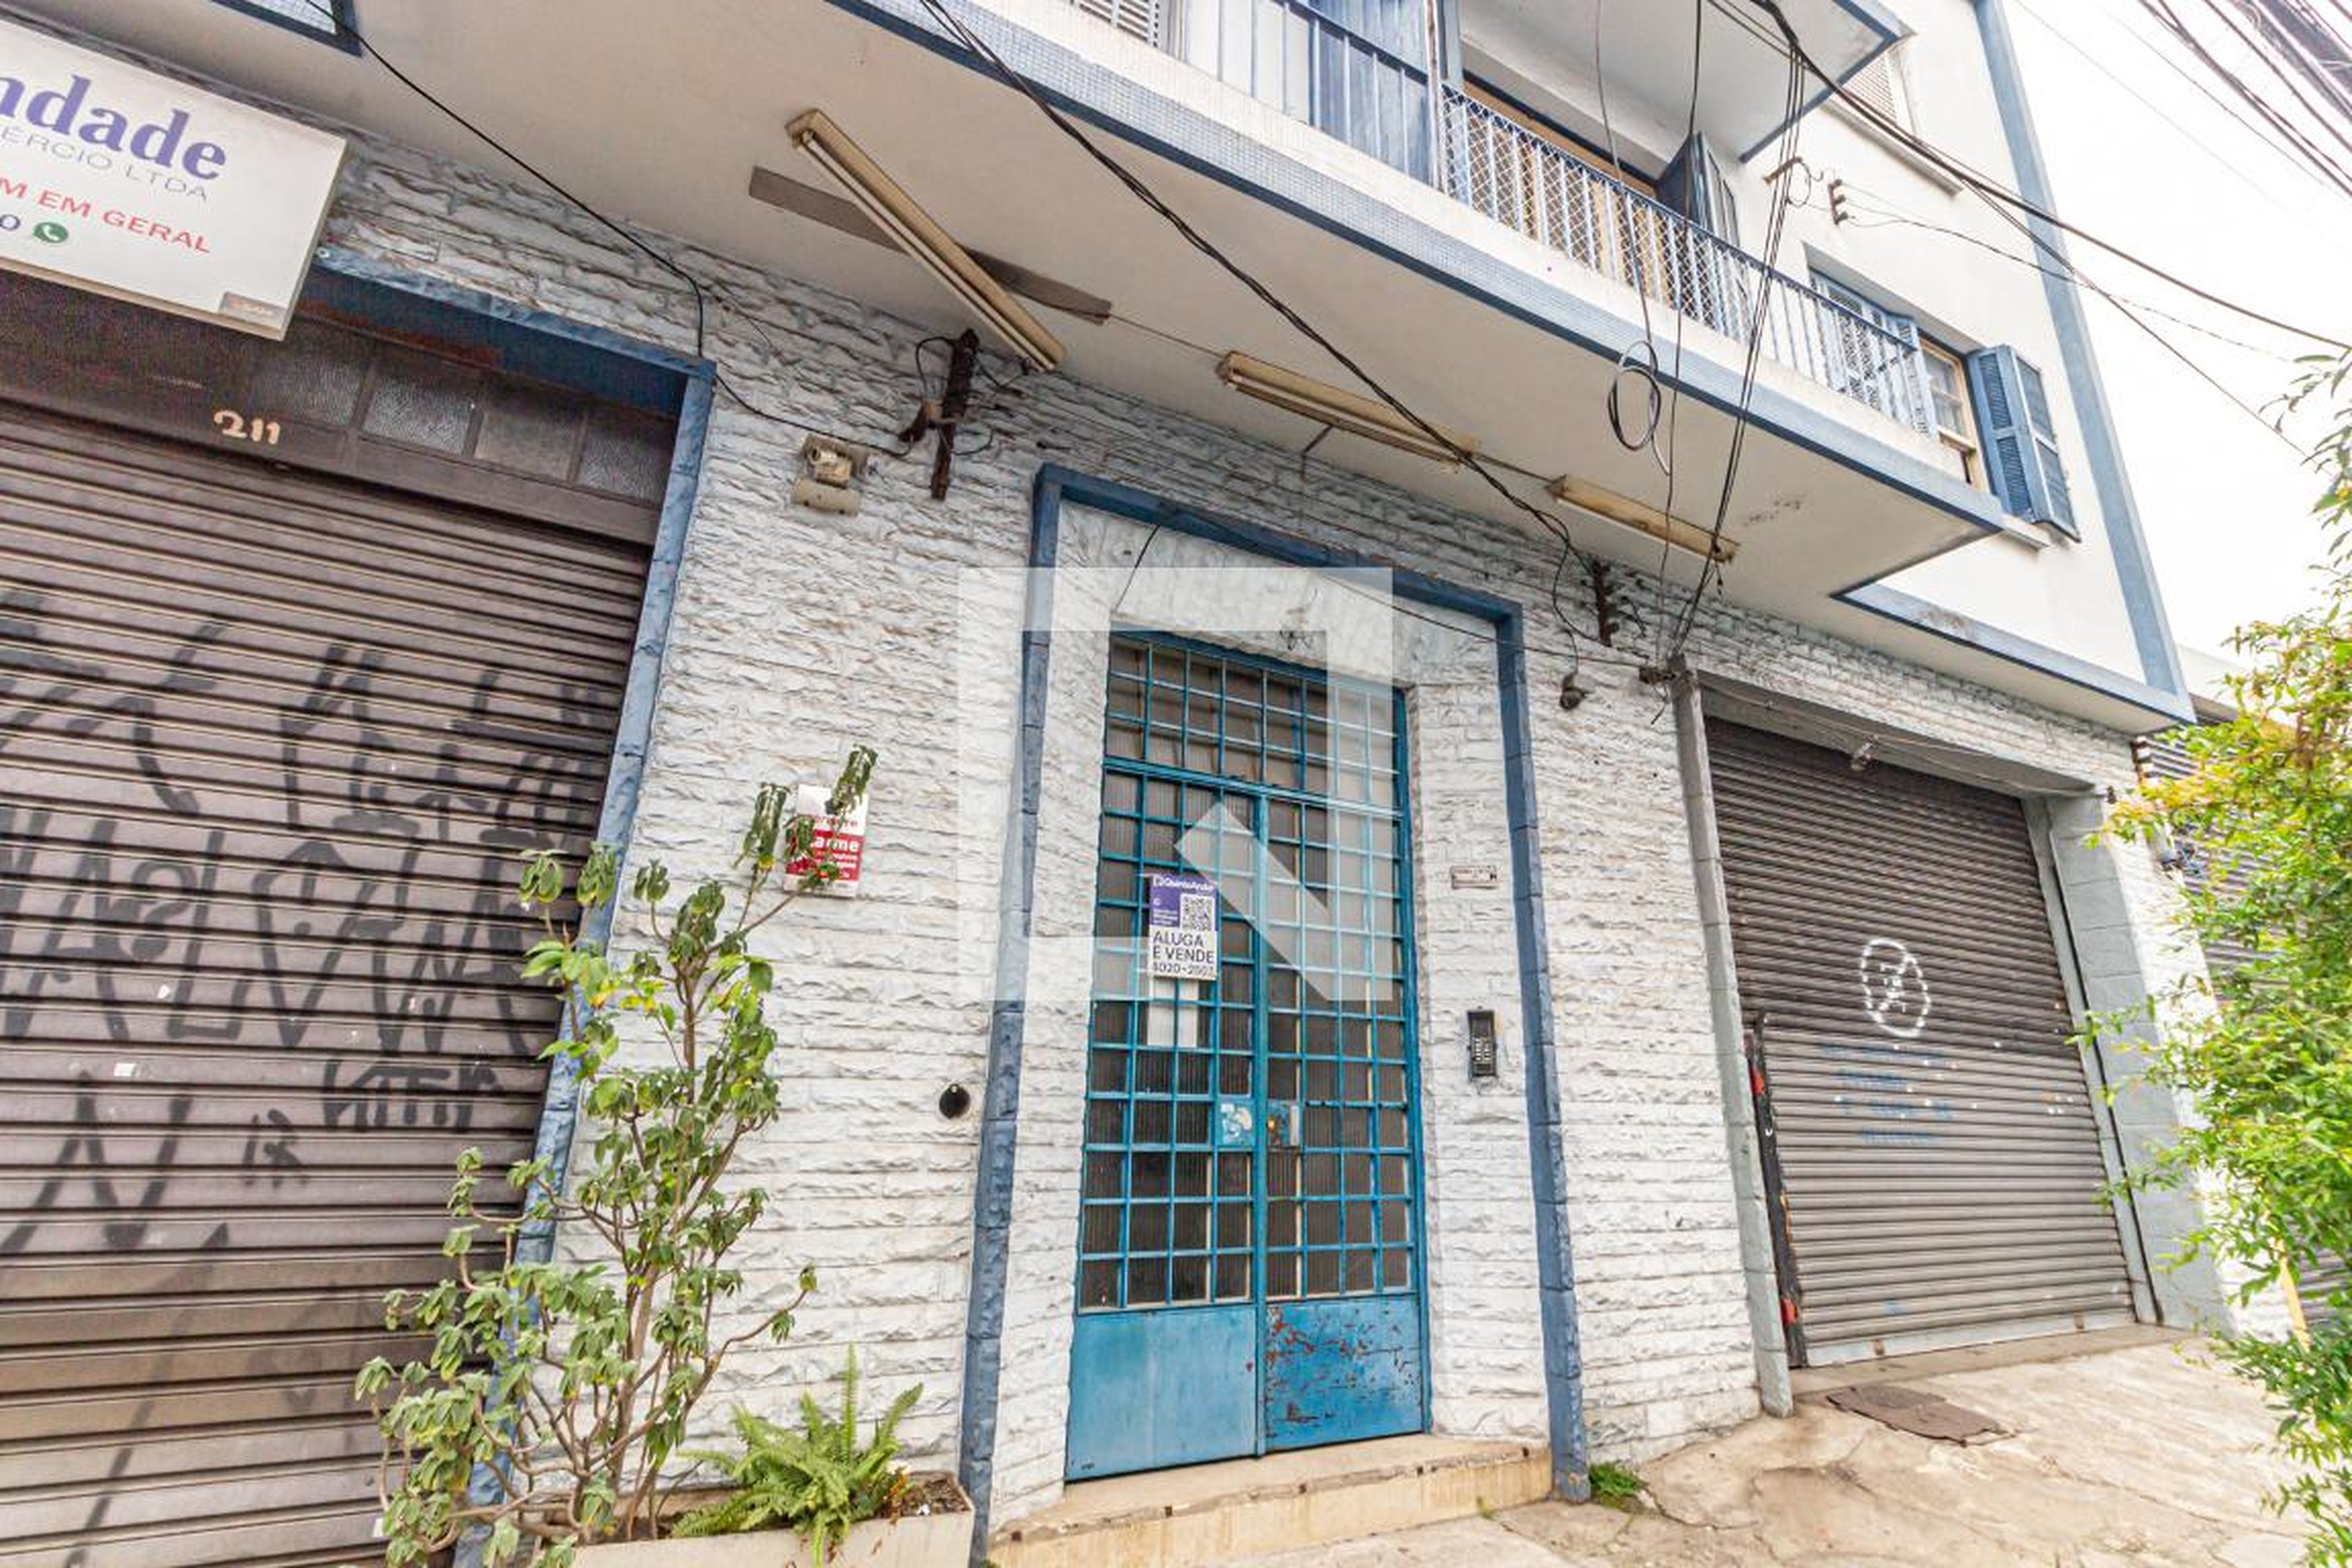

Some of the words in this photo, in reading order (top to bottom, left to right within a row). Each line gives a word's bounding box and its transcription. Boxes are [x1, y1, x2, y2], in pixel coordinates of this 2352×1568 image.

[125, 165, 207, 201] LTDA
[39, 190, 91, 218] EM
[102, 209, 210, 254] GERAL
[214, 410, 281, 444] 211
[1153, 930, 1204, 947] ALUGA
[1153, 946, 1161, 960] E
[1165, 947, 1215, 963] VENDE
